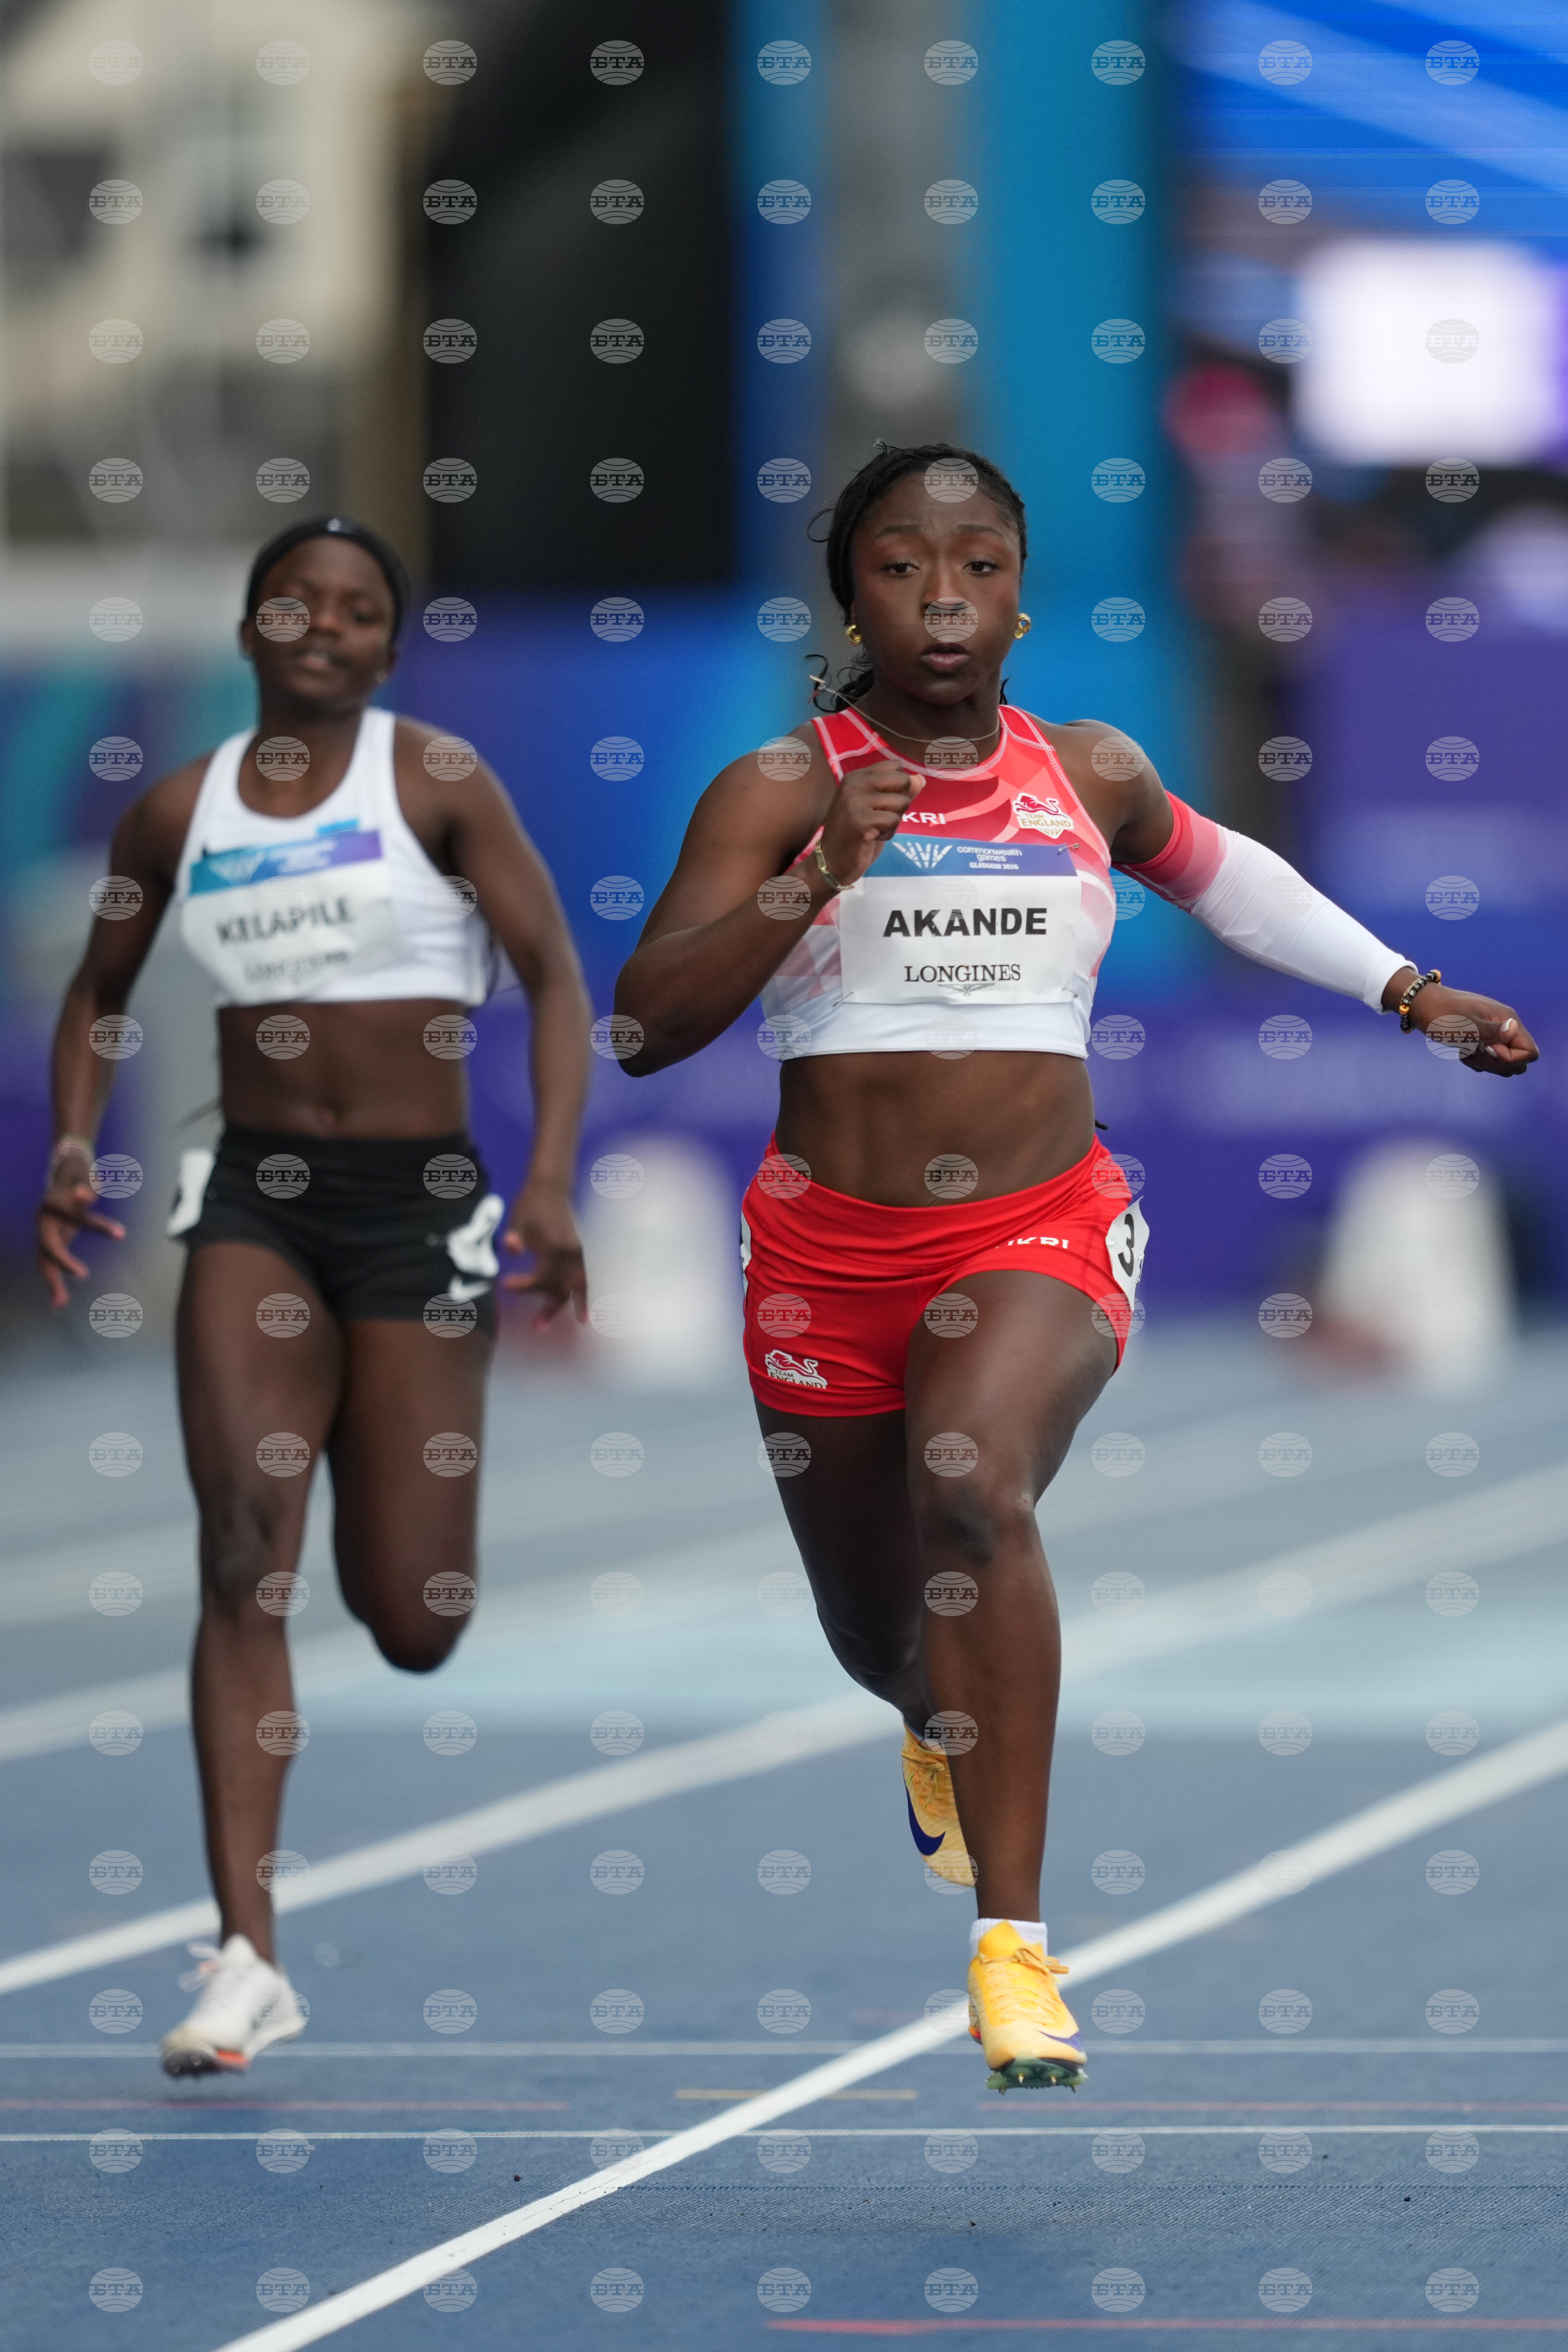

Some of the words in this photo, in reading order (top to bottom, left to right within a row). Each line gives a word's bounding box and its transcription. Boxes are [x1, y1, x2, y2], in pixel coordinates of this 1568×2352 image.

[902, 812, 946, 825] KRI
[1020, 818, 1071, 827] ENGLAND
[956, 846, 1022, 856] commonwealth
[976, 854, 1007, 862] games
[883, 908, 1047, 937] AKANDE
[904, 964, 1021, 982] LONGINES
[1118, 1213, 1135, 1277] 3
[775, 1369, 798, 1378] TEAM
